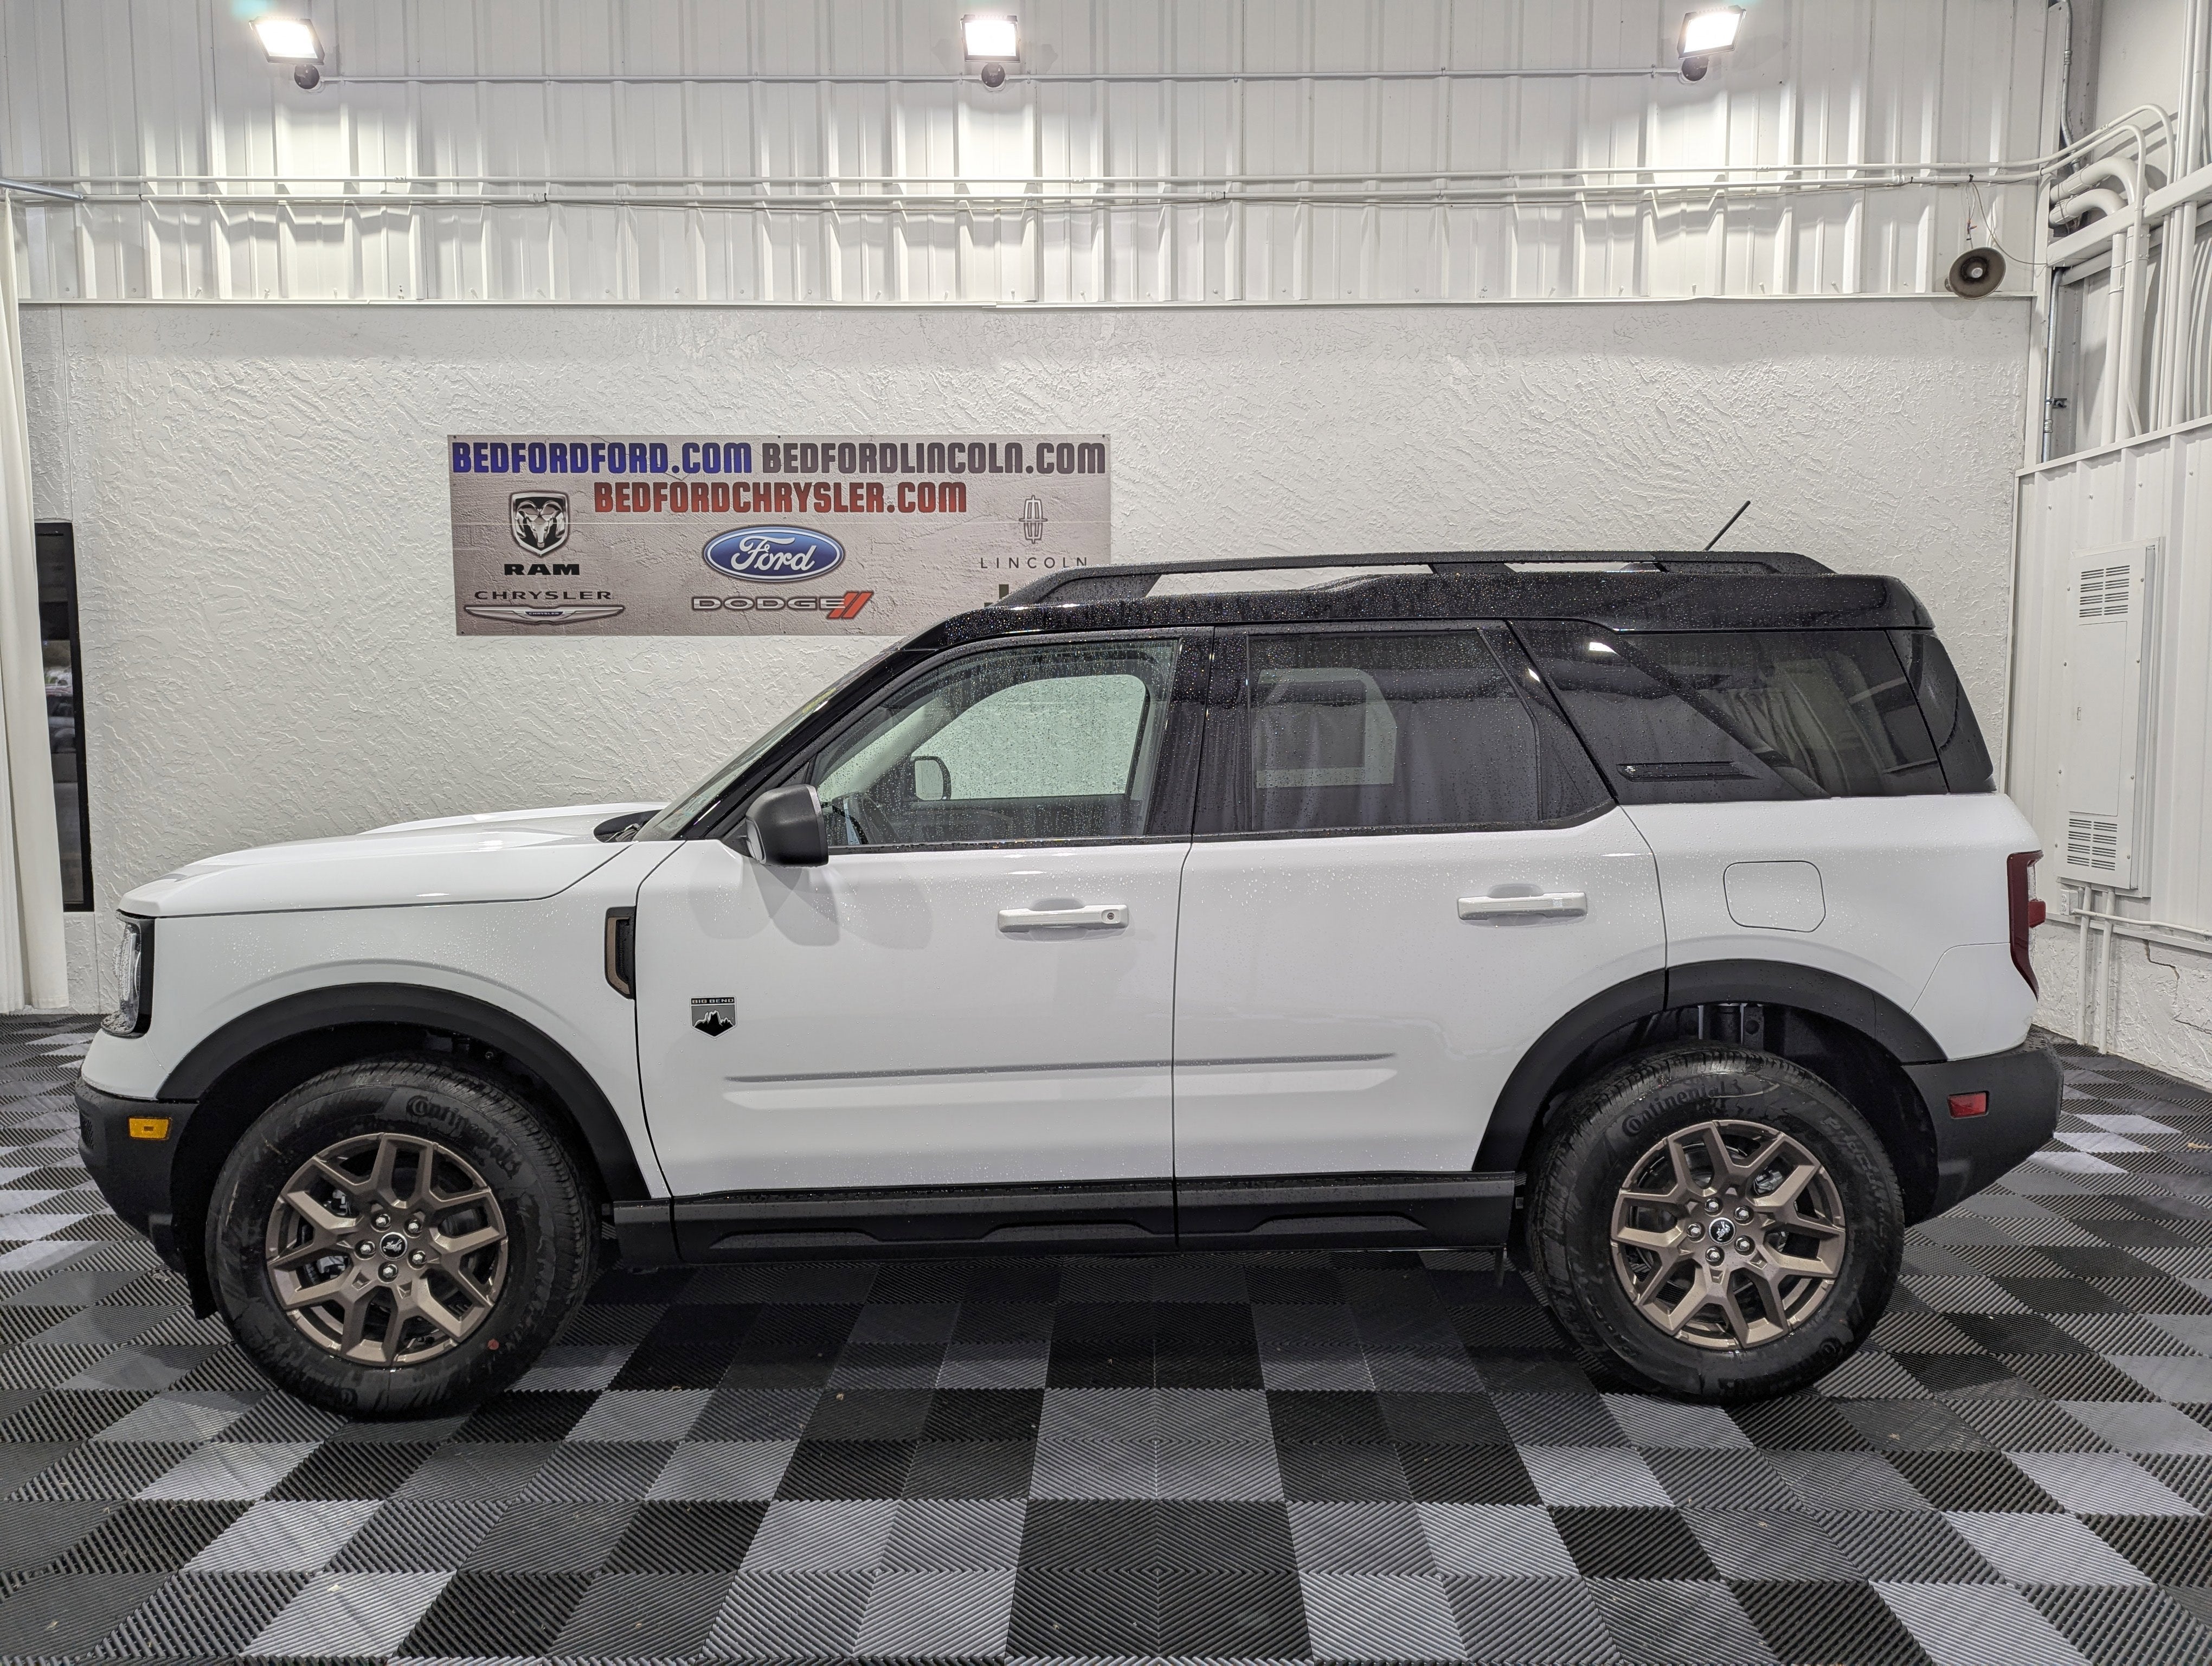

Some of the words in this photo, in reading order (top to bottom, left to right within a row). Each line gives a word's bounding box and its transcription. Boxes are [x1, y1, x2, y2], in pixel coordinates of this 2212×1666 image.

[452, 442, 752, 473] BEDFORDFORD.COM
[762, 443, 1105, 473] BEDFORDLINCOLN.COM
[594, 482, 967, 512] BEDFORDCHRYSLER.COM
[731, 535, 817, 571] Ford
[980, 557, 1087, 568] LINCOLN
[504, 563, 580, 575] RAM
[474, 591, 612, 600] CHRYSLER
[692, 597, 846, 610] DODGE
[1622, 1081, 1725, 1137] Continental
